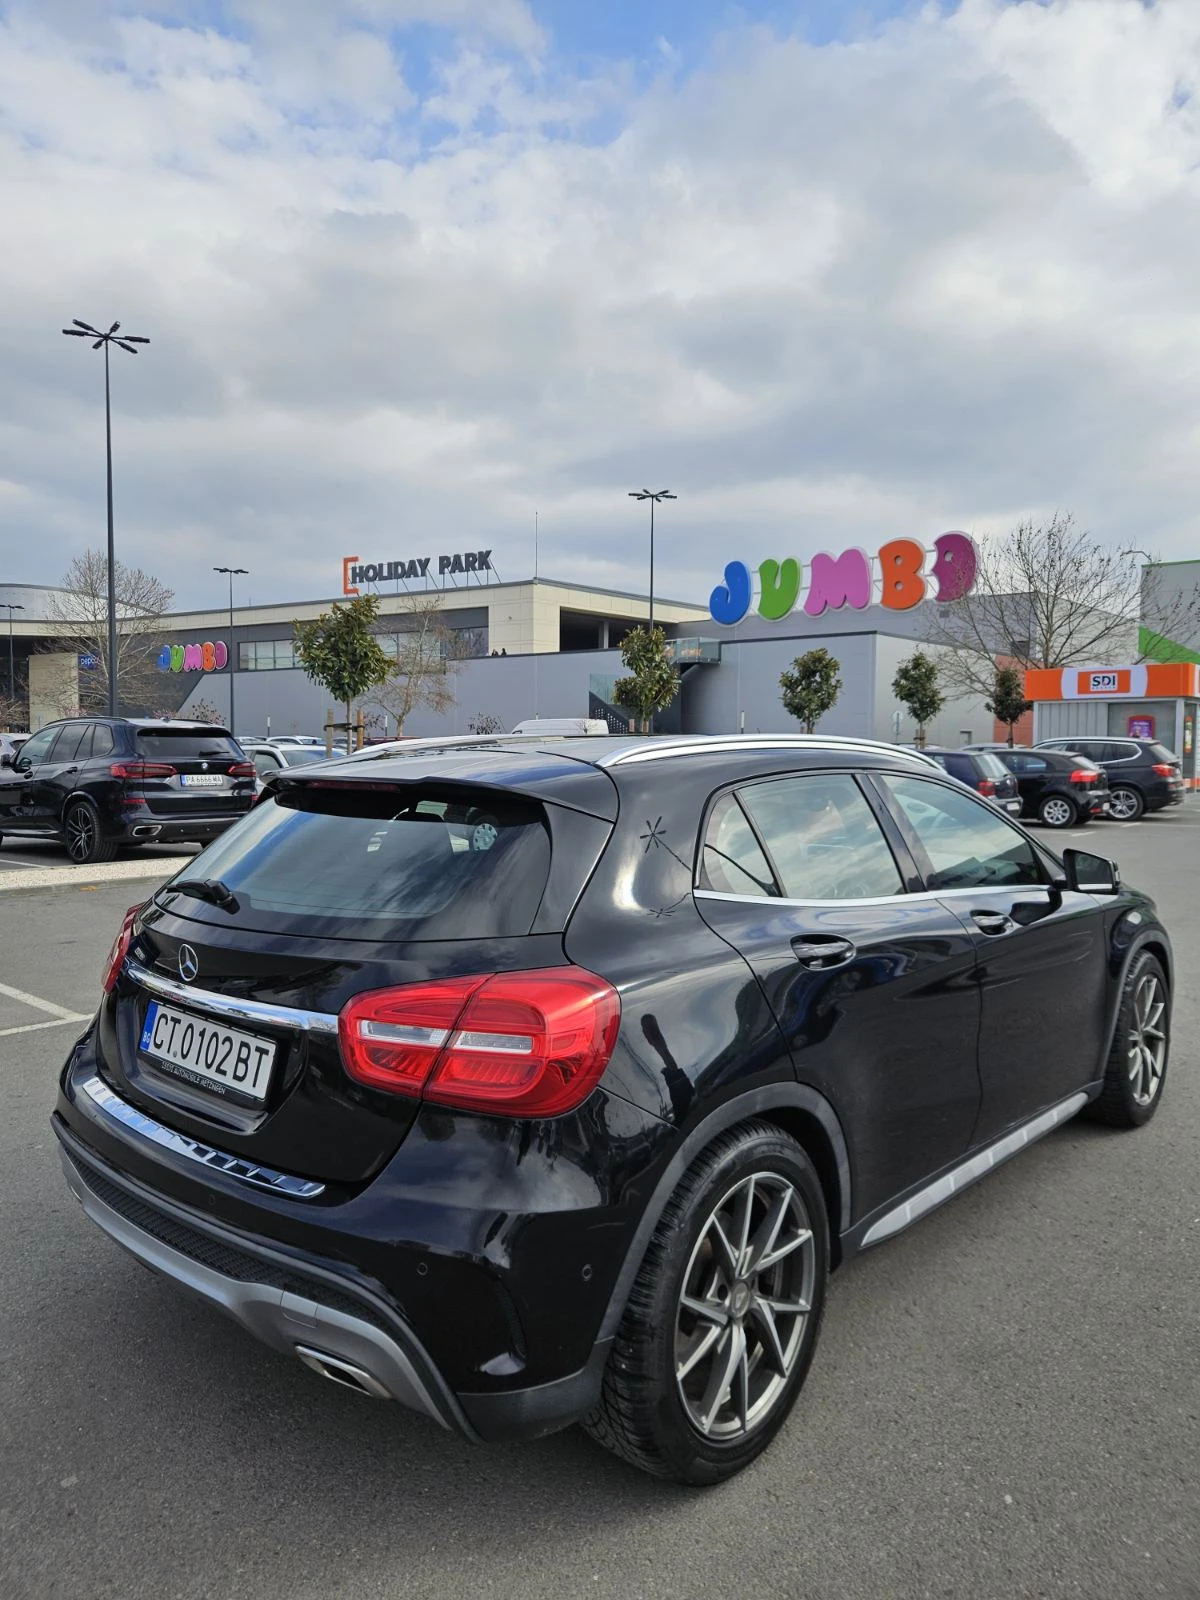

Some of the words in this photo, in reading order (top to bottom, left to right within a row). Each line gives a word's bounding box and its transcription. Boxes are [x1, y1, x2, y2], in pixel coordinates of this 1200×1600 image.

[350, 558, 431, 584] HOLIDAY
[438, 550, 492, 575] PARK
[708, 530, 979, 627] JUMBO
[156, 640, 228, 673] JUMBO
[1092, 675, 1116, 687] SDI
